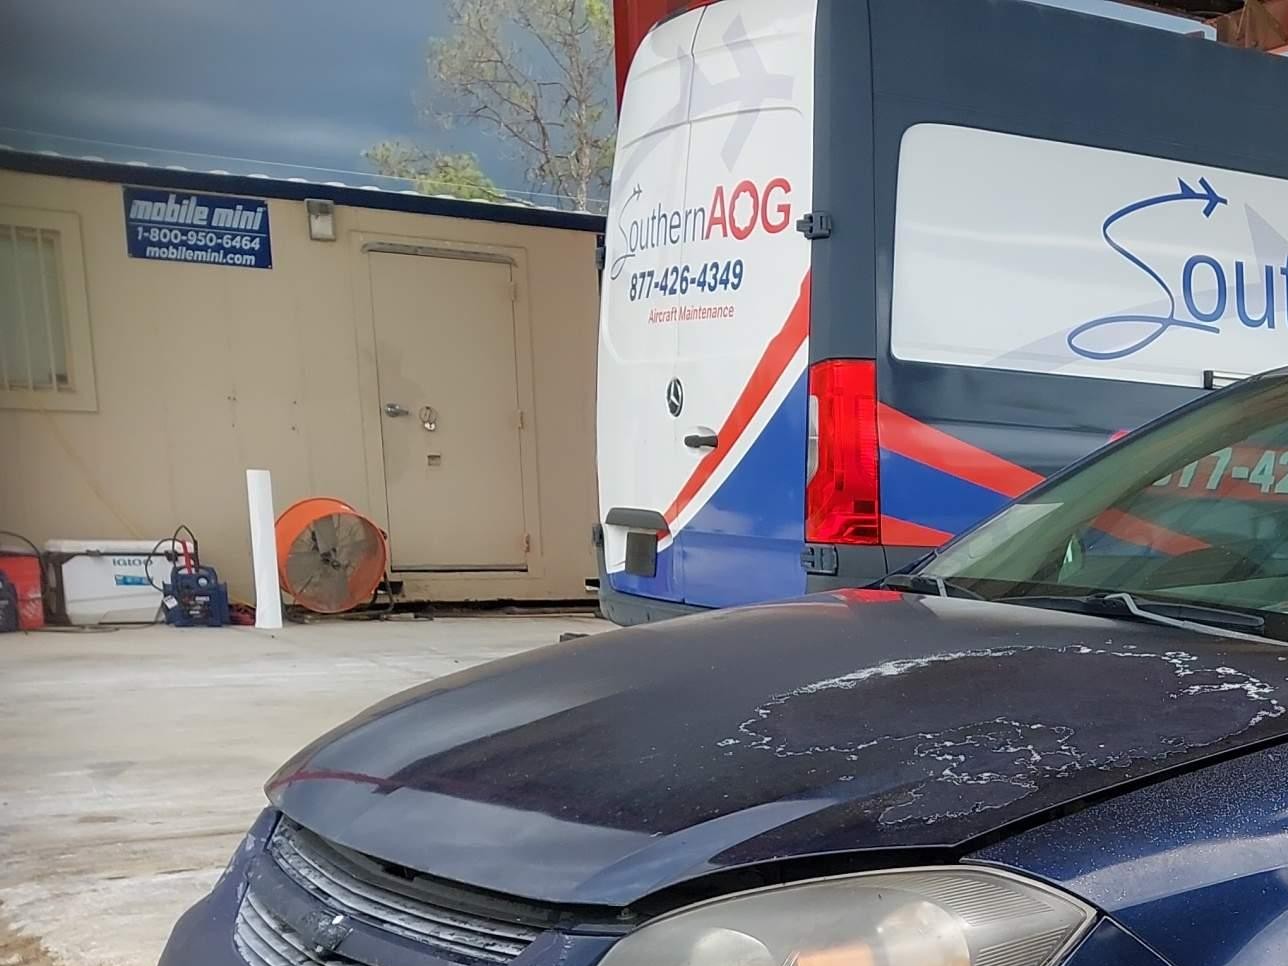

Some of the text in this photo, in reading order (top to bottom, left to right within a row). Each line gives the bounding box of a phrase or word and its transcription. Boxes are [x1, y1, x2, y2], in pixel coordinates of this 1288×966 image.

[129, 194, 264, 230] mobile mini
[136, 227, 260, 250] 1-800-950-6464
[145, 246, 256, 265] mobilemini.com
[629, 259, 744, 301] 877-426-4349
[648, 304, 735, 324] Aircraft Maintenance
